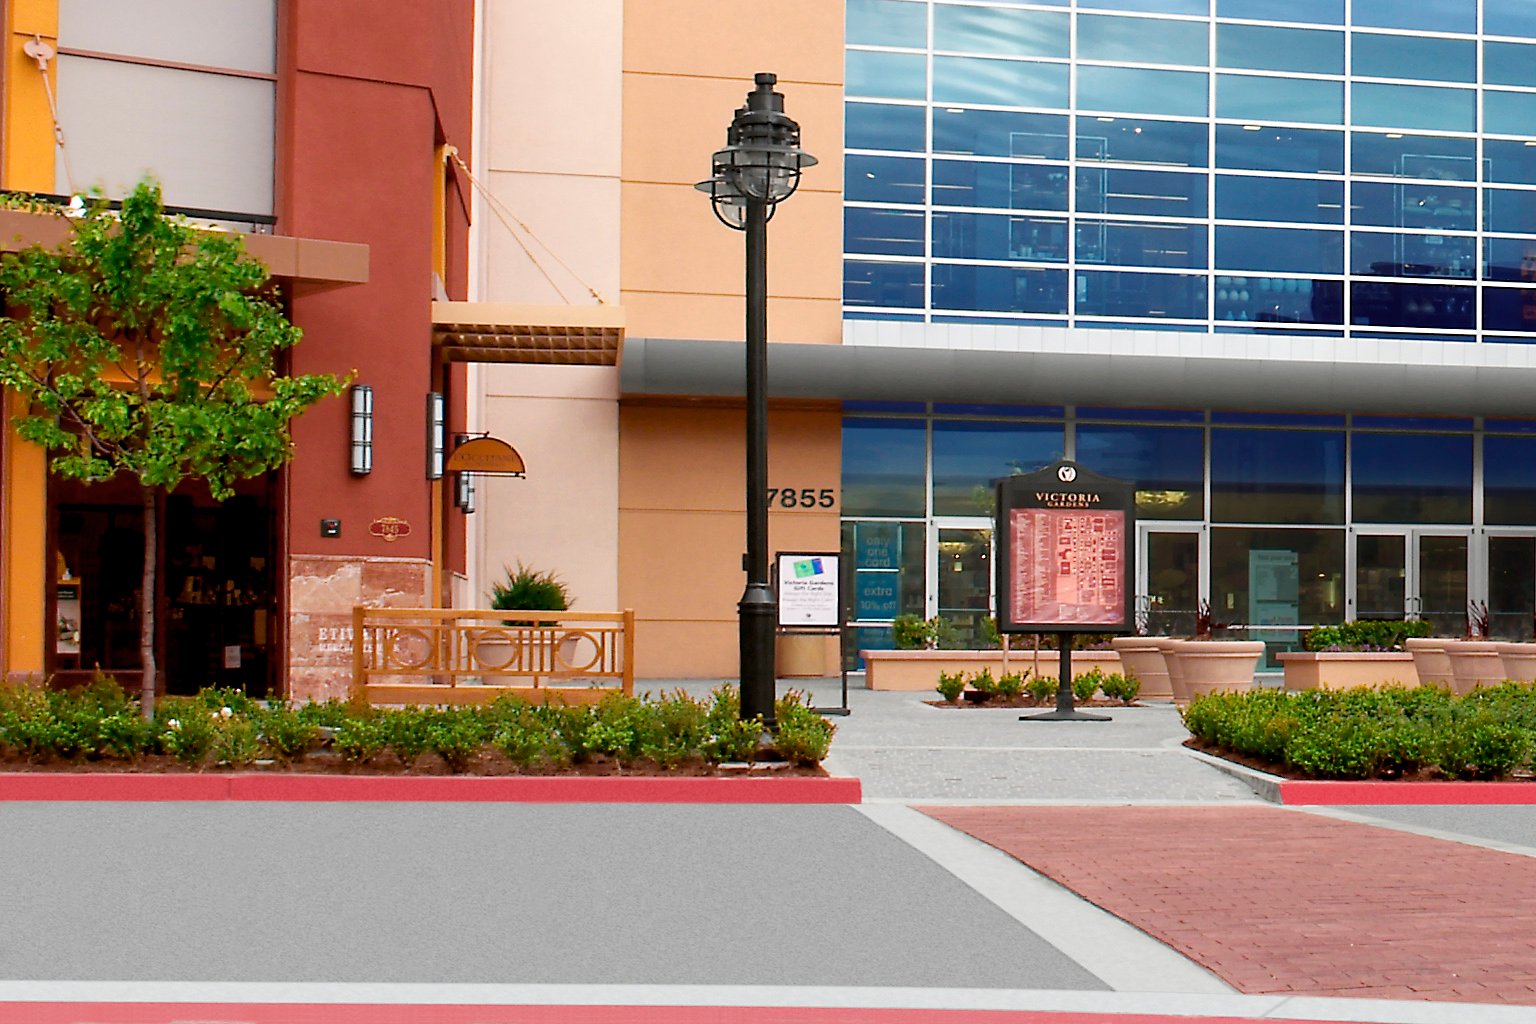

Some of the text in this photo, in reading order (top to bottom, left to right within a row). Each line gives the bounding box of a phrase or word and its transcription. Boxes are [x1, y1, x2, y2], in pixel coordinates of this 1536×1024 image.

[767, 488, 835, 508] 7855
[1035, 492, 1101, 503] VICTORIA
[867, 547, 888, 557] one
[864, 557, 891, 568] card
[863, 586, 893, 597] extra
